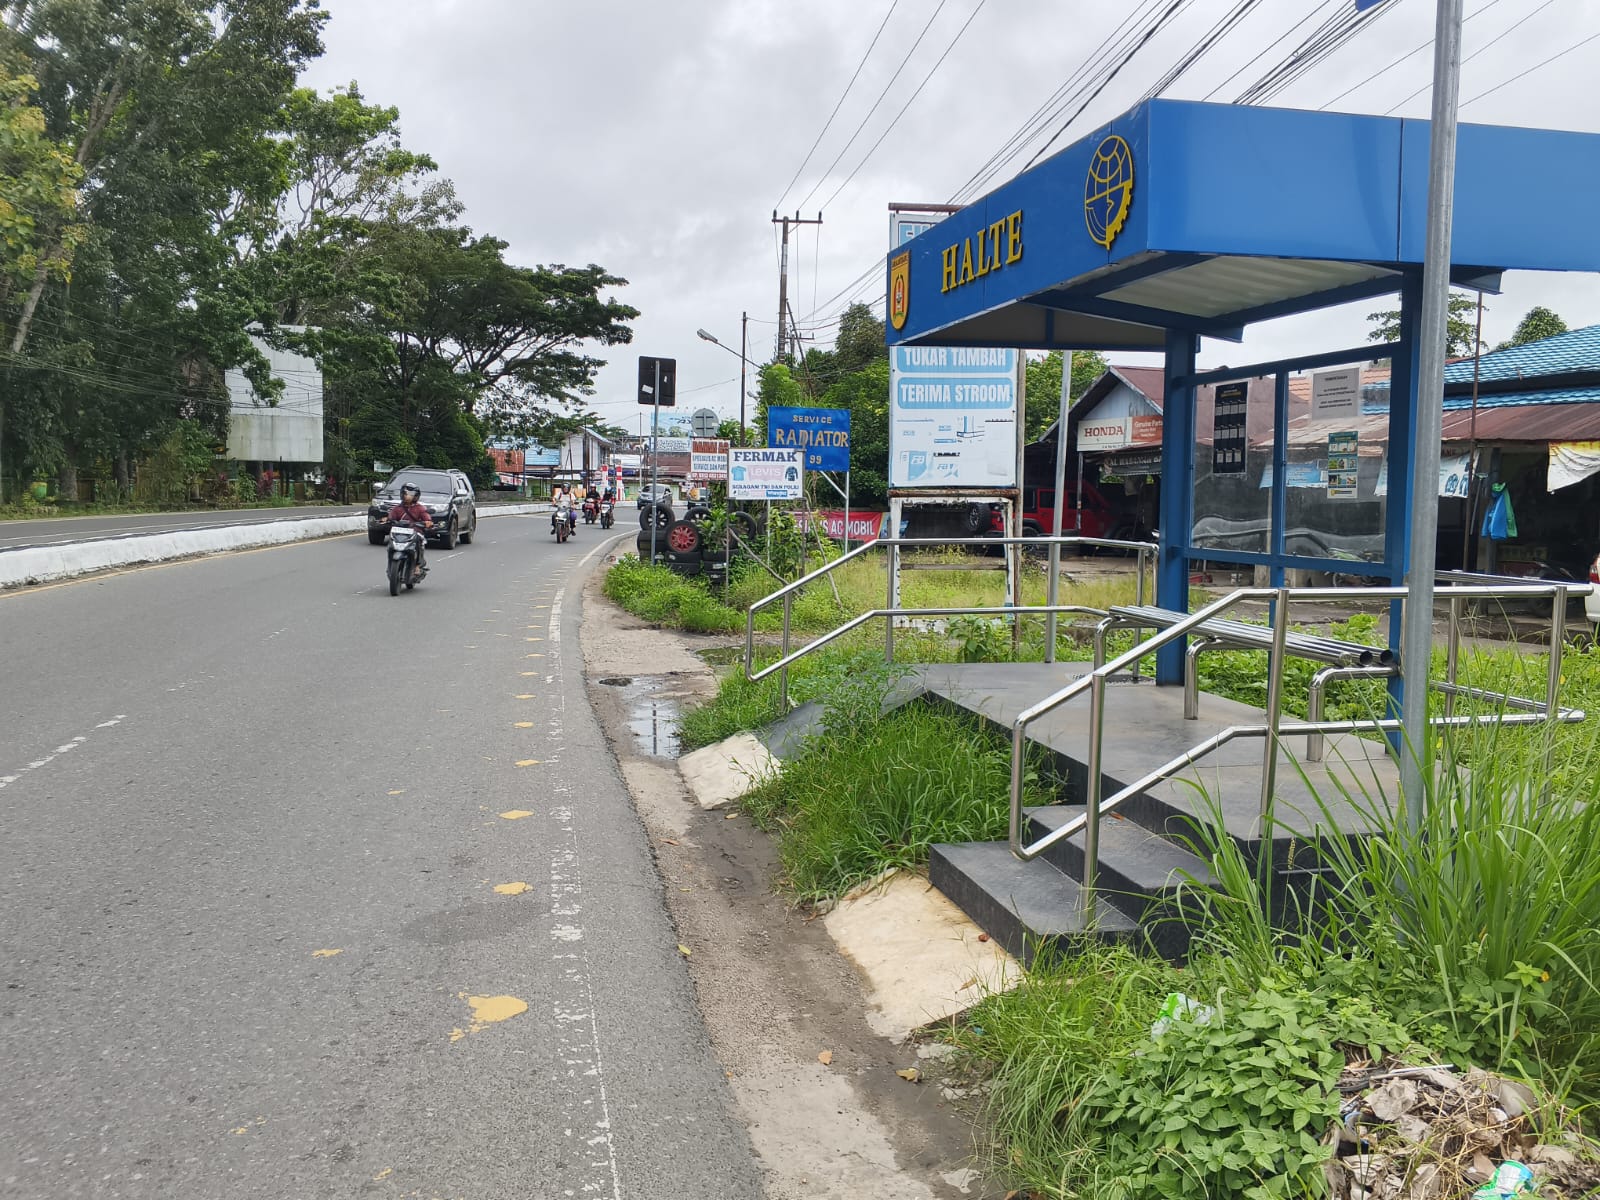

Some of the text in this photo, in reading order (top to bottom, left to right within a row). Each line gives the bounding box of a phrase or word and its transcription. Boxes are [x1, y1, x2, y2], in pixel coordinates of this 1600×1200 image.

[940, 209, 1023, 293] HALTE
[903, 348, 1007, 367] TUKAR TAMBAH
[901, 384, 1010, 403] TERIMA STROOM
[792, 414, 832, 424] SERVICE
[775, 428, 849, 448] RADIATOR
[1084, 425, 1124, 437] HONDA
[734, 451, 798, 463] FERMAK
[809, 455, 822, 465] 99
[831, 520, 844, 535] AC
[847, 520, 875, 536] MOBIL
